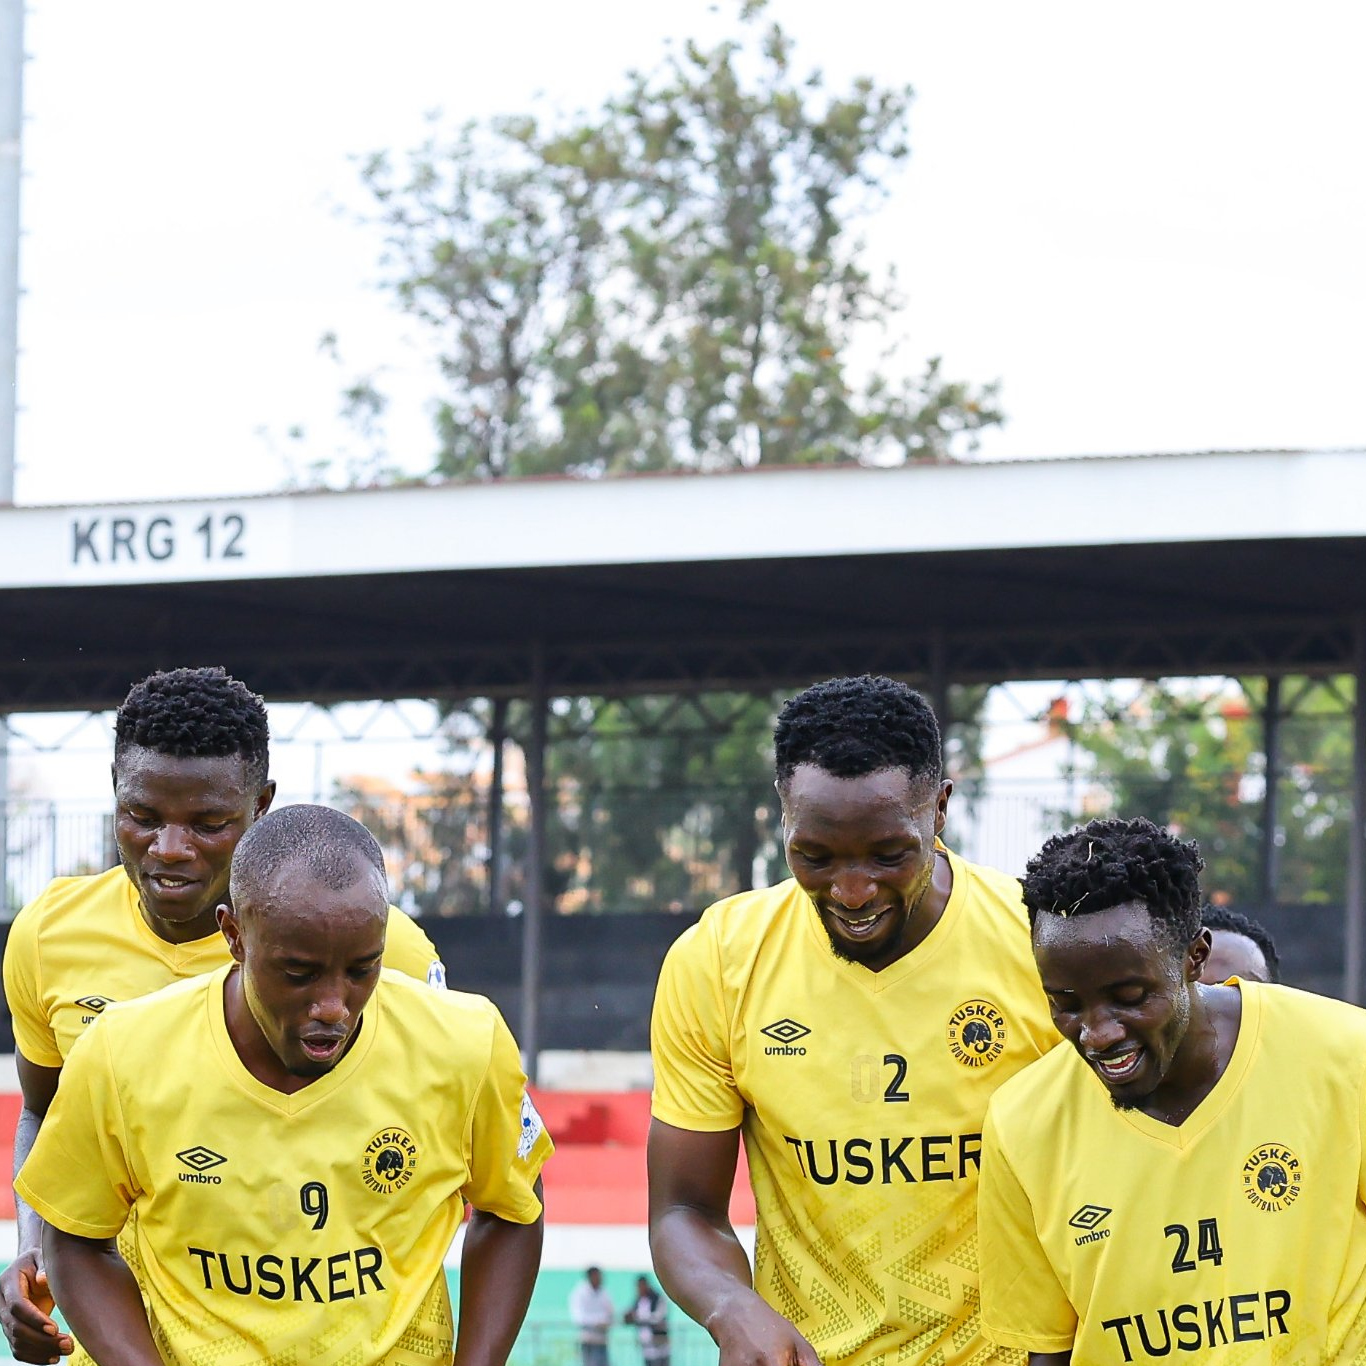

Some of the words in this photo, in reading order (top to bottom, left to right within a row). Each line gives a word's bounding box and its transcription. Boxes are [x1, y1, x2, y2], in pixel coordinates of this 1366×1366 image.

[72, 517, 174, 563] KRG
[197, 514, 244, 559] 12
[949, 1004, 1004, 1028] TUSKER
[764, 1044, 807, 1056] umbro
[949, 1042, 984, 1067] FOOTBALL
[985, 1042, 1004, 1062] CLUB
[365, 1132, 416, 1156] TUSKER
[783, 1133, 983, 1185] TUSKER
[1243, 1148, 1299, 1172] TUSKER
[178, 1172, 222, 1185] umbro
[361, 1169, 393, 1194] FOOTBALL
[394, 1170, 413, 1190] CLUB
[299, 1181, 329, 1231] 9
[1245, 1187, 1283, 1212] FOOTBALL
[1282, 1185, 1300, 1206] CLUB
[1075, 1228, 1111, 1247] umbro
[1163, 1217, 1224, 1274] 24
[187, 1246, 386, 1304] TUSKER
[1101, 1289, 1292, 1363] TUSKER
